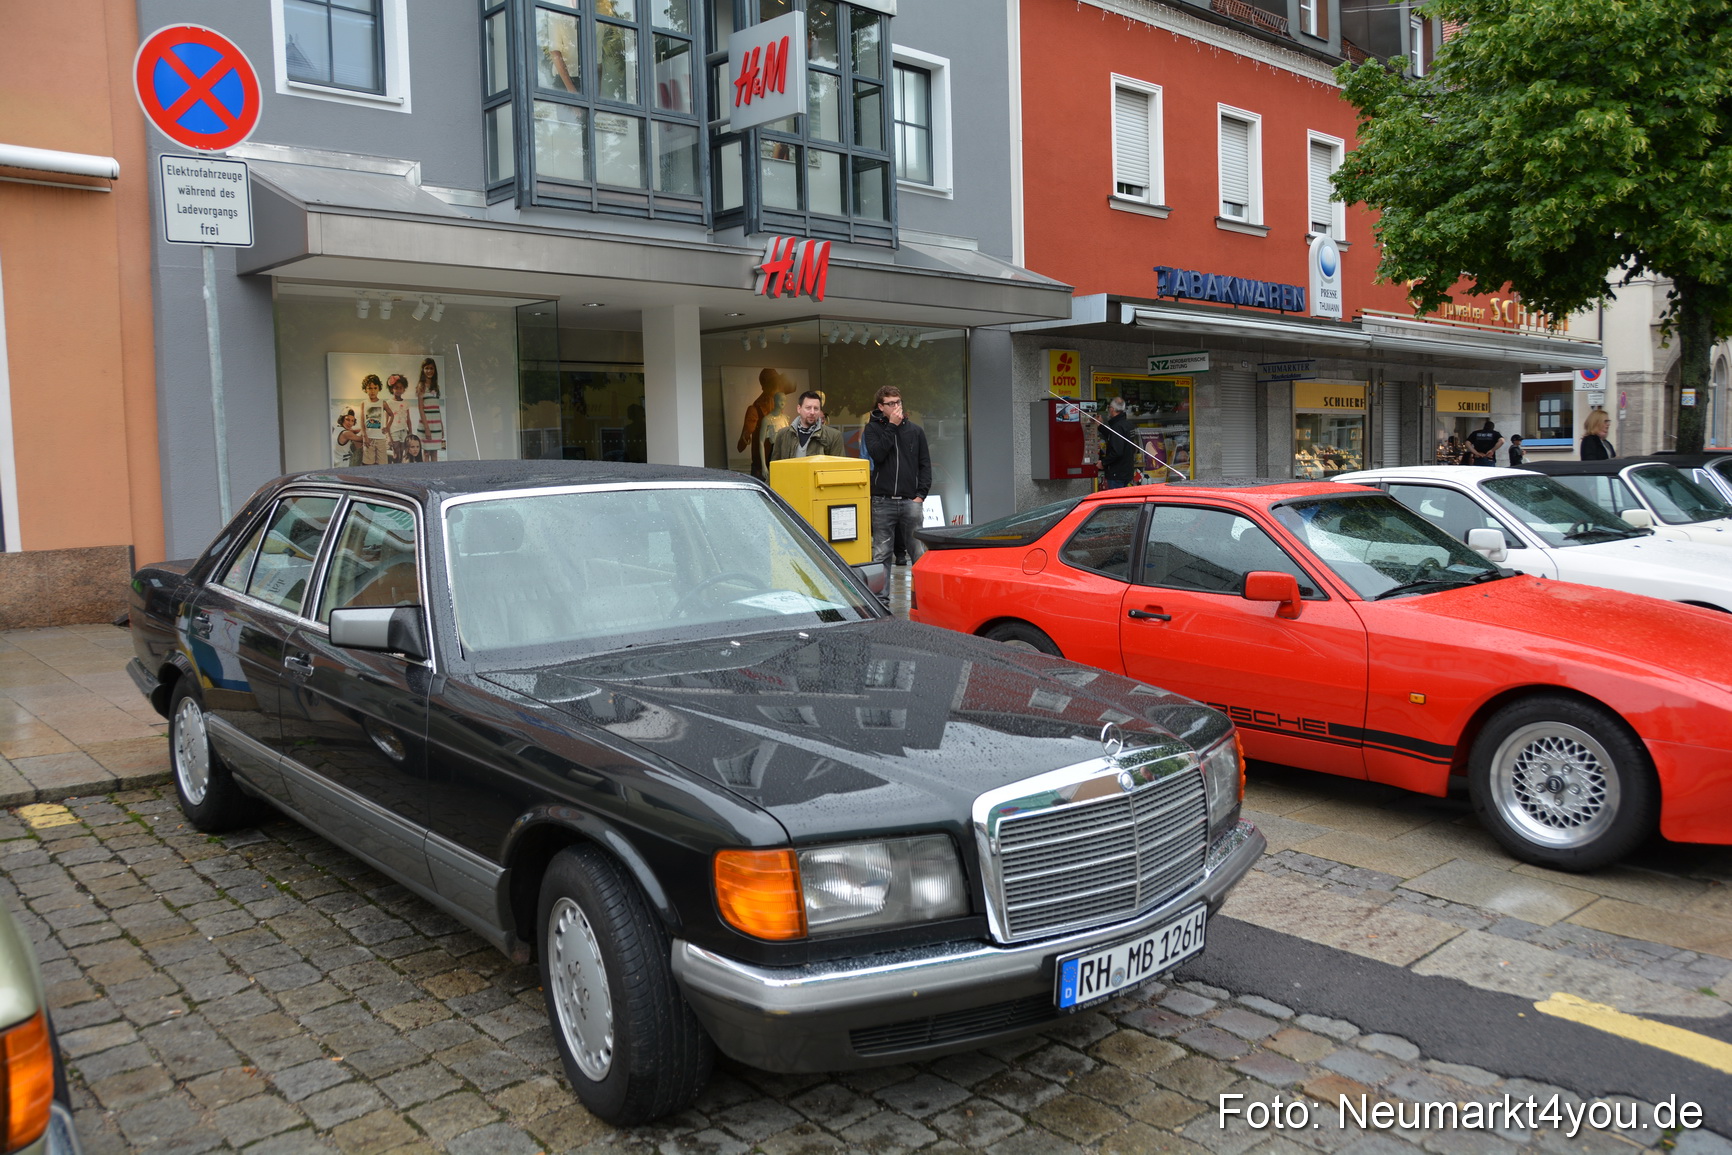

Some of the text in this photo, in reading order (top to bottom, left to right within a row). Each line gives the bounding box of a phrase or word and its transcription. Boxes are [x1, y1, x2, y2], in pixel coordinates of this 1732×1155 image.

[734, 35, 790, 107] H&M
[166, 164, 243, 183] Elektrofahrzeuge
[177, 185, 235, 198] während des
[176, 203, 238, 219] Ladevorgangs
[200, 223, 219, 236] frei
[756, 235, 832, 302] H&M
[1153, 265, 1306, 312] TABAKWAREN
[1320, 288, 1338, 299] PRESSE
[1150, 359, 1170, 371] NZ
[1262, 363, 1310, 374] NEUMARKTER
[1052, 375, 1077, 387] LOTTO
[1196, 701, 1327, 735] RSCHE
[1065, 911, 1205, 999] D RH MB 126H
